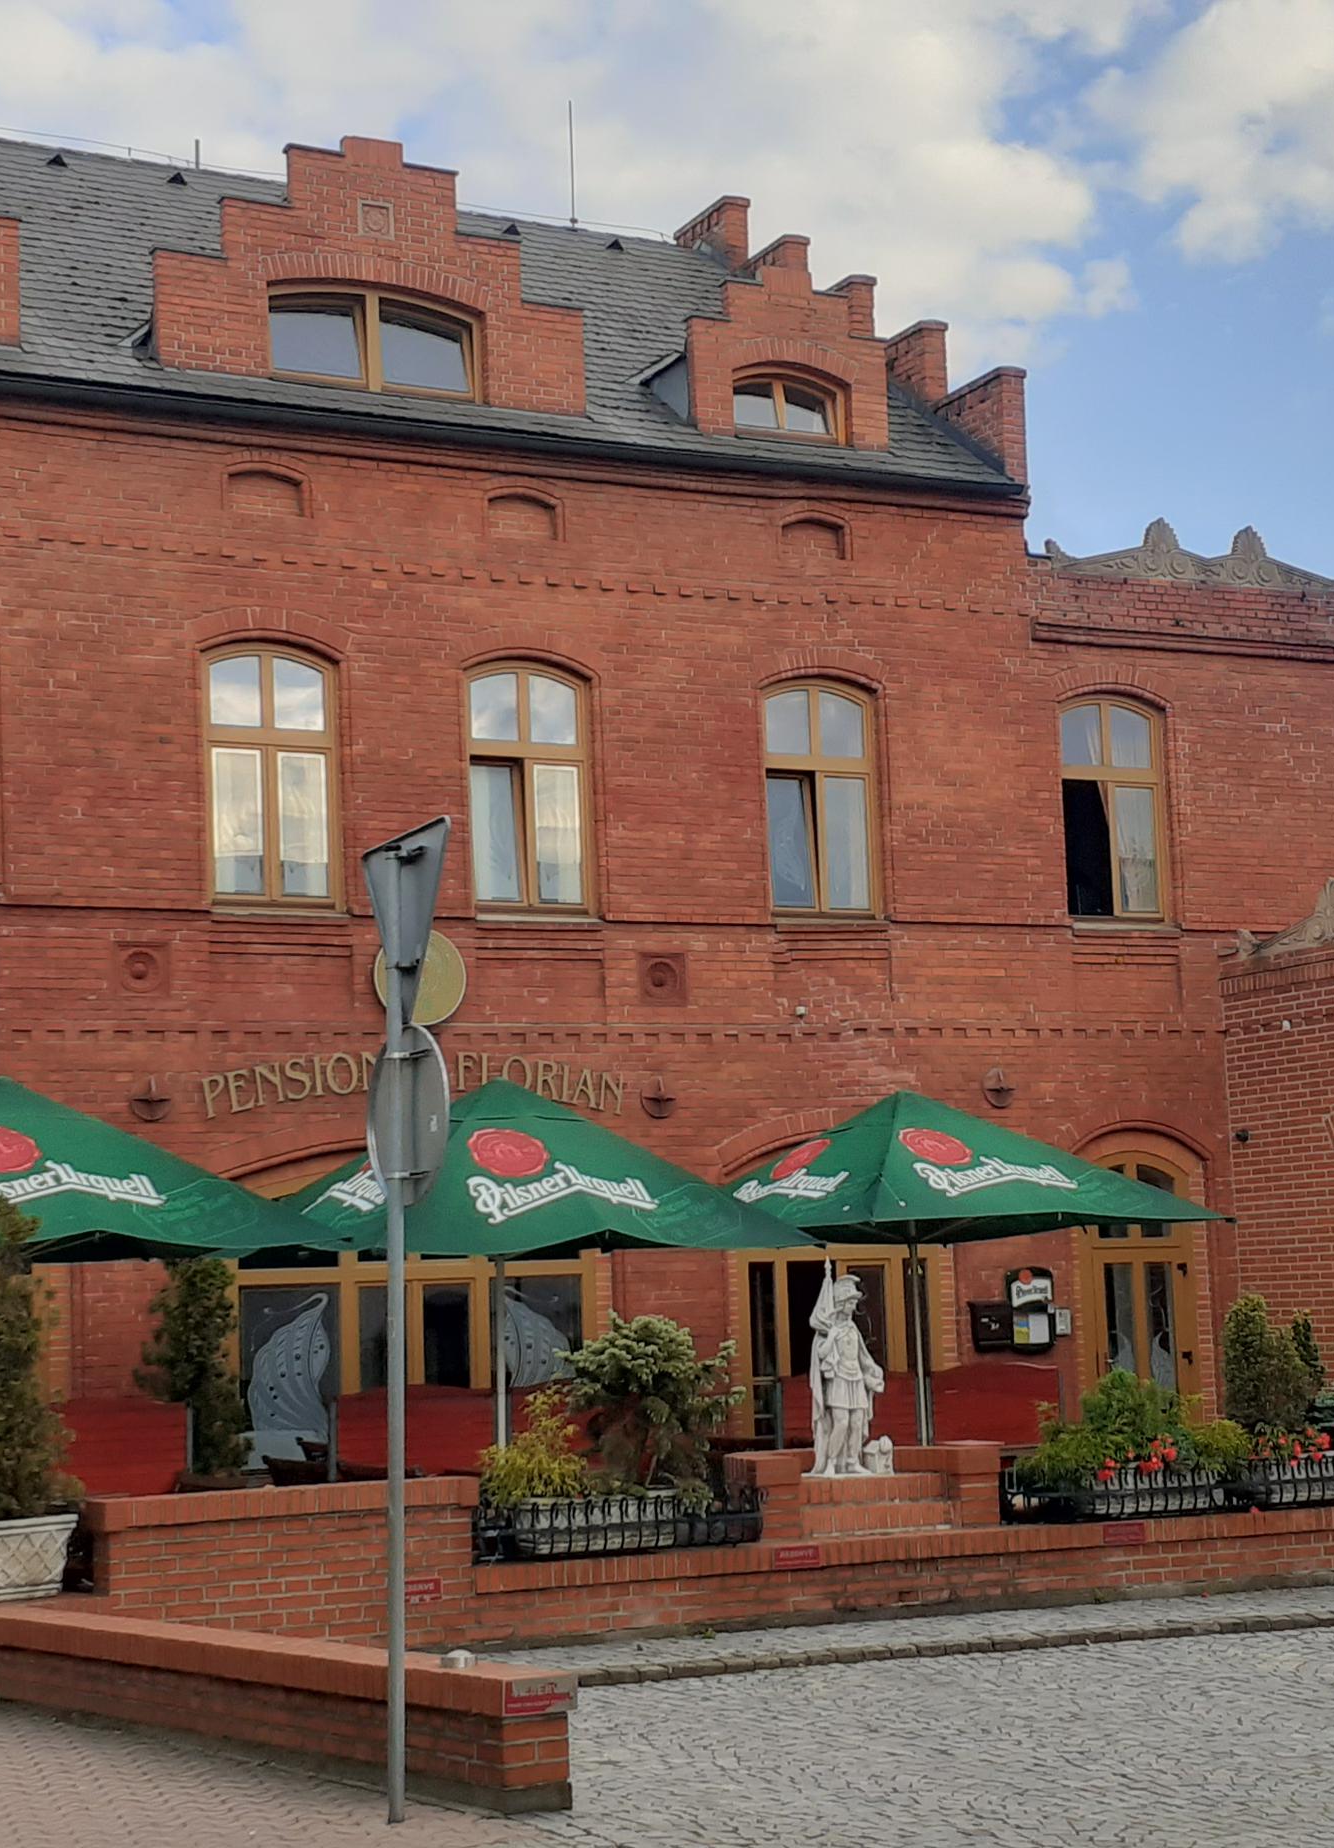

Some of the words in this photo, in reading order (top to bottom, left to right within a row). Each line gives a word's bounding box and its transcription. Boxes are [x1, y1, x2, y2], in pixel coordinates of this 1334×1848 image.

[45, 1160, 167, 1200] Urquell
[340, 1169, 386, 1207] Urque
[466, 1172, 567, 1225] Pilsner
[555, 1161, 660, 1204] Urquell
[912, 1162, 997, 1198] Pilsner
[979, 1156, 1078, 1187] Urquell
